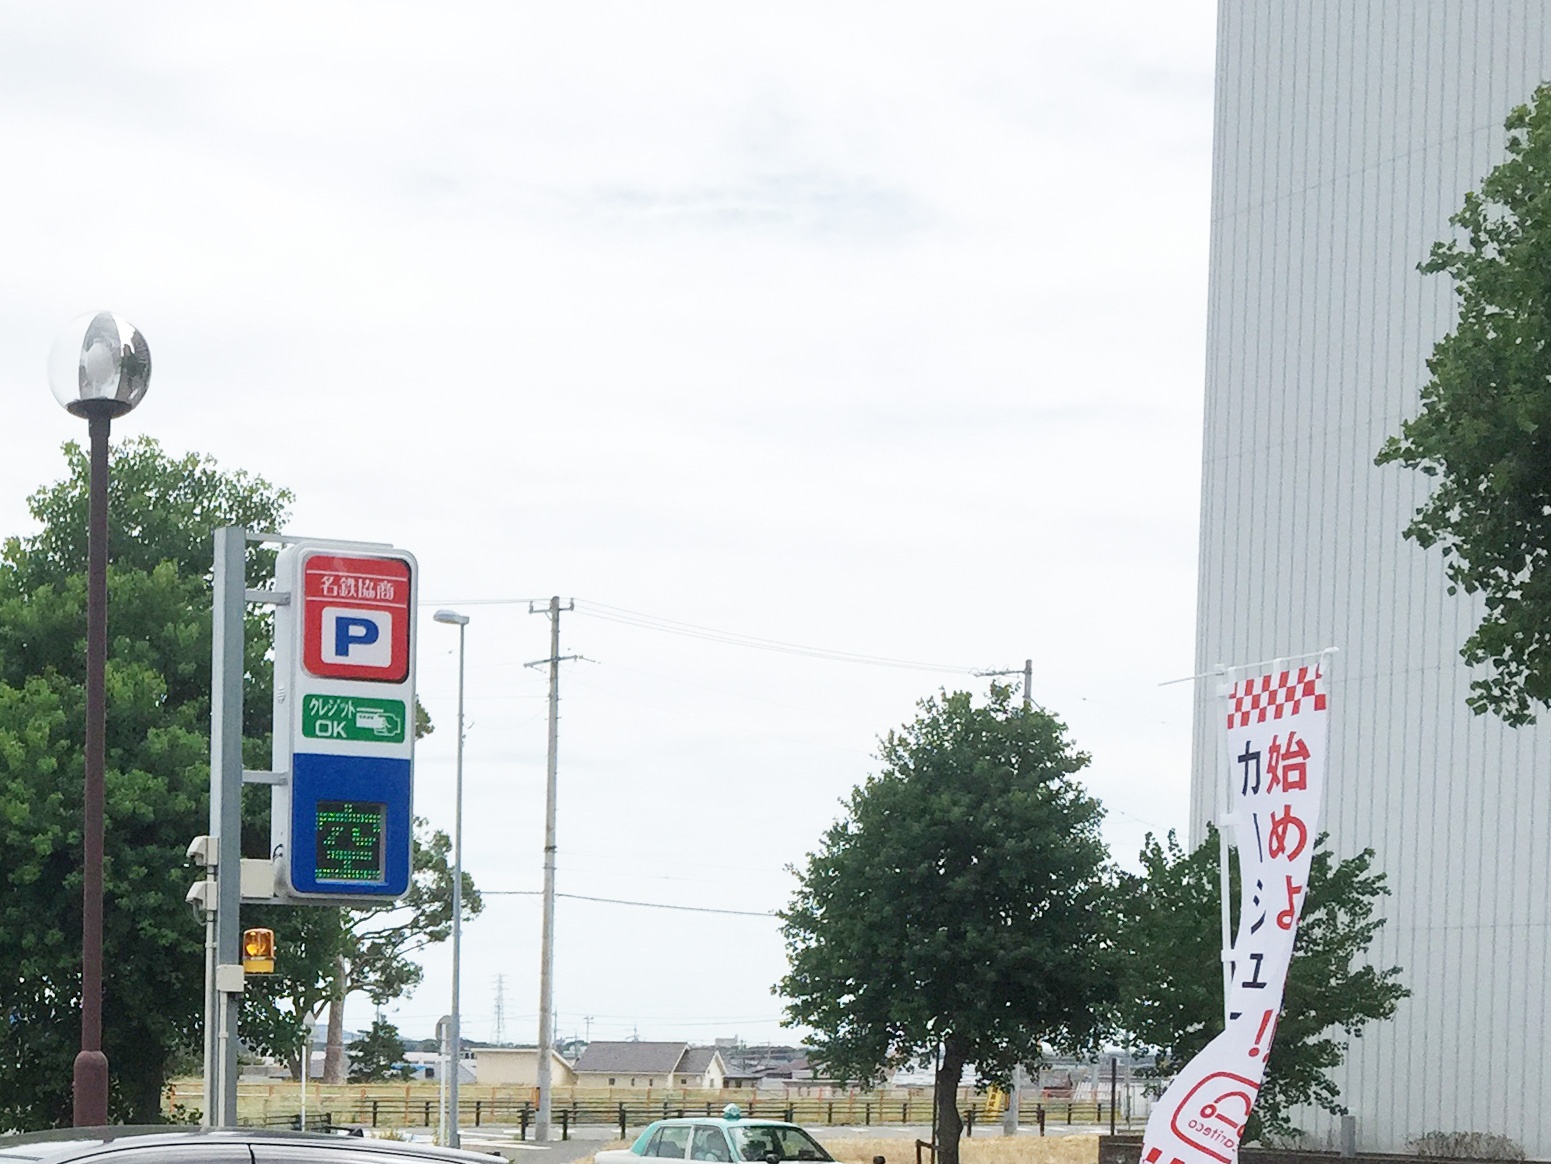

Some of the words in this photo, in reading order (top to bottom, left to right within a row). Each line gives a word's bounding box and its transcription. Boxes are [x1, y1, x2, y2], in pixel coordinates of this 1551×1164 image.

[321, 576, 394, 600] 名鉄協商
[335, 616, 379, 657] P
[309, 697, 356, 719] クレジット
[315, 719, 347, 738] OK
